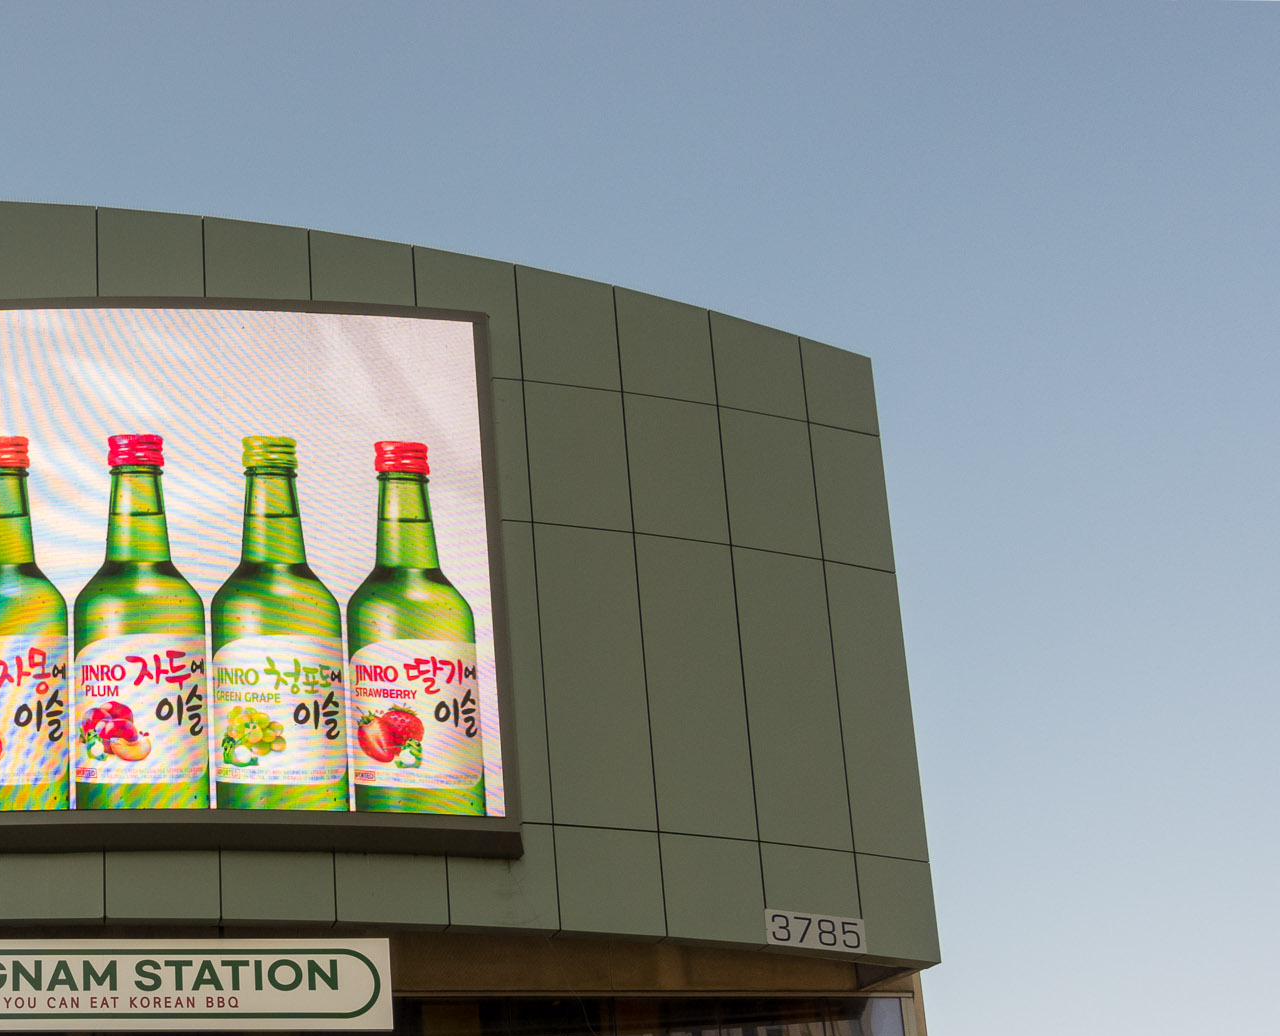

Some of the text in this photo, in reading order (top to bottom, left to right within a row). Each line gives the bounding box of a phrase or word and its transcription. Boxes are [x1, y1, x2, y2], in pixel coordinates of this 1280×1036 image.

[81, 664, 126, 685] JINRO
[126, 650, 204, 690] 자두에
[216, 668, 259, 686] JINRO
[355, 665, 398, 685] JINRO
[403, 656, 476, 694] 딸기에
[85, 685, 119, 697] PLUM
[216, 690, 280, 703] GREEN GRAPE
[355, 687, 417, 700] STRAWBERRY
[14, 690, 63, 741] 이슬
[156, 684, 204, 736] 이슬
[294, 691, 340, 740] 이슬
[434, 689, 477, 737] 이슬
[771, 914, 861, 949] 3785
[134, 958, 339, 992] STATION
[5, 997, 36, 1009] YOU
[47, 997, 80, 1009] CAN
[90, 997, 119, 1009] EAT
[129, 997, 196, 1009] KOREAN
[205, 997, 240, 1009] BBQ
